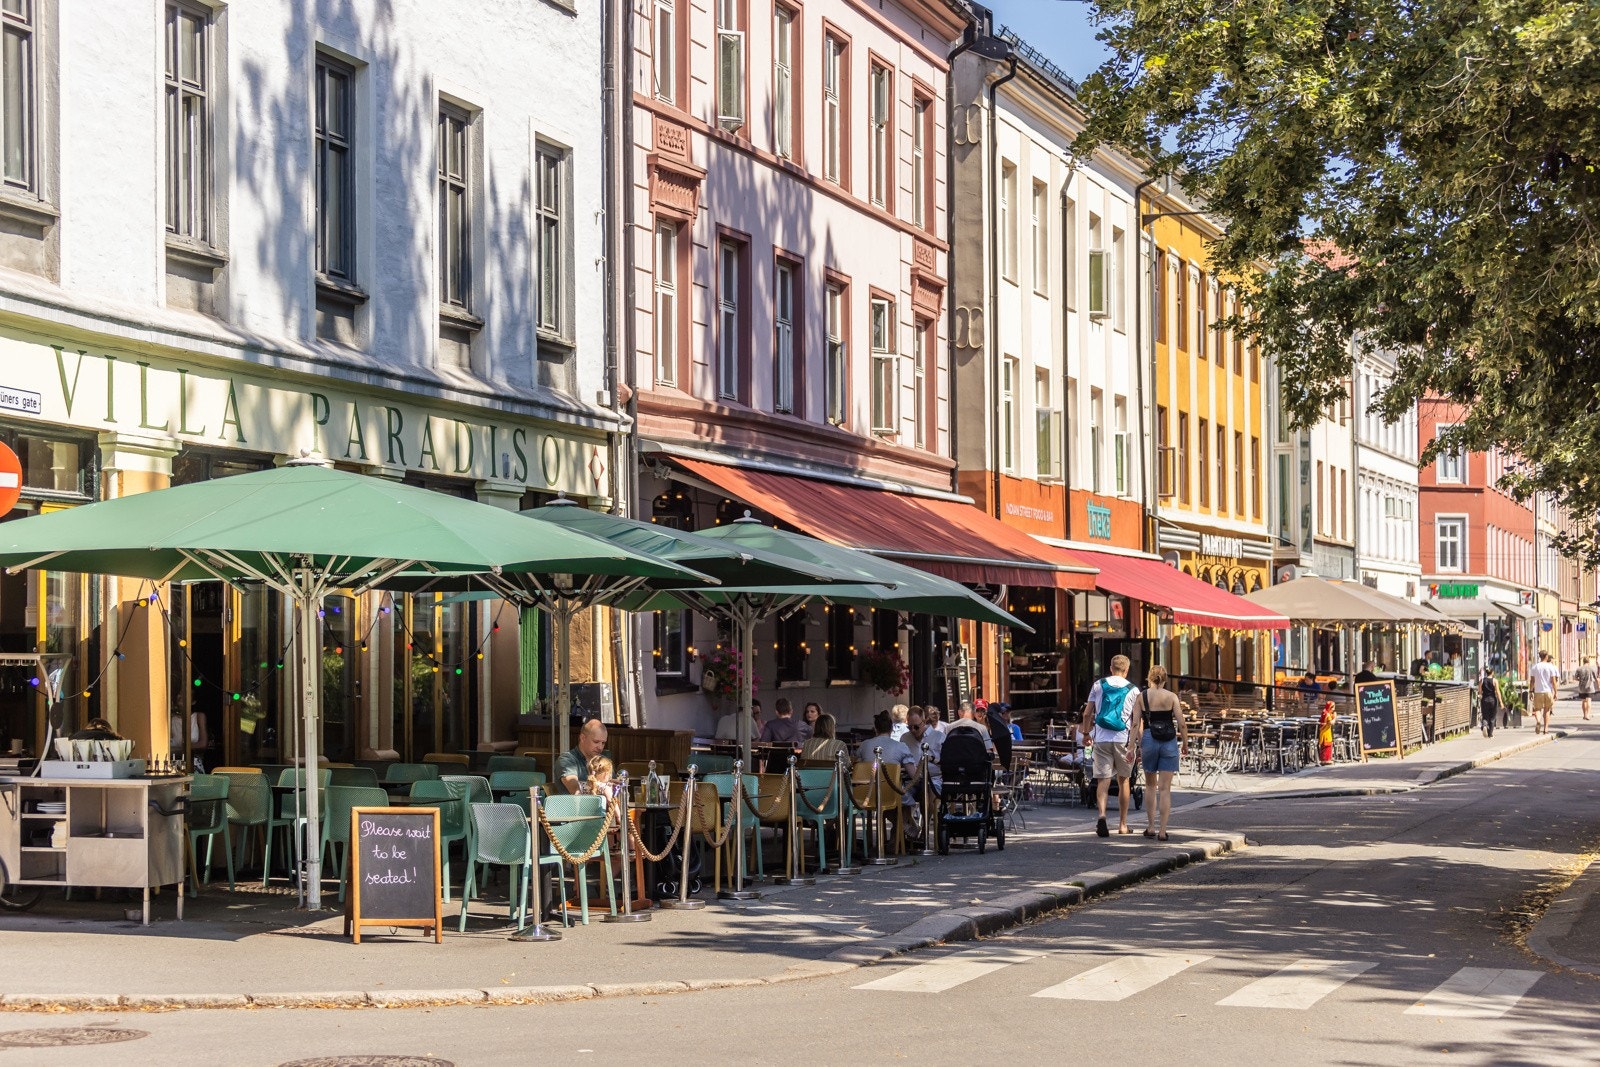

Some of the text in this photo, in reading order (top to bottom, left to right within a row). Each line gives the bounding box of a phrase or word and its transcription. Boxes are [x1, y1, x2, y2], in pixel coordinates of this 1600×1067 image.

[0, 391, 37, 409] üners gate
[50, 344, 561, 486] VILLA PARADISO
[361, 820, 431, 839] Please wait
[372, 844, 407, 860] to be
[365, 866, 417, 884] seated!
